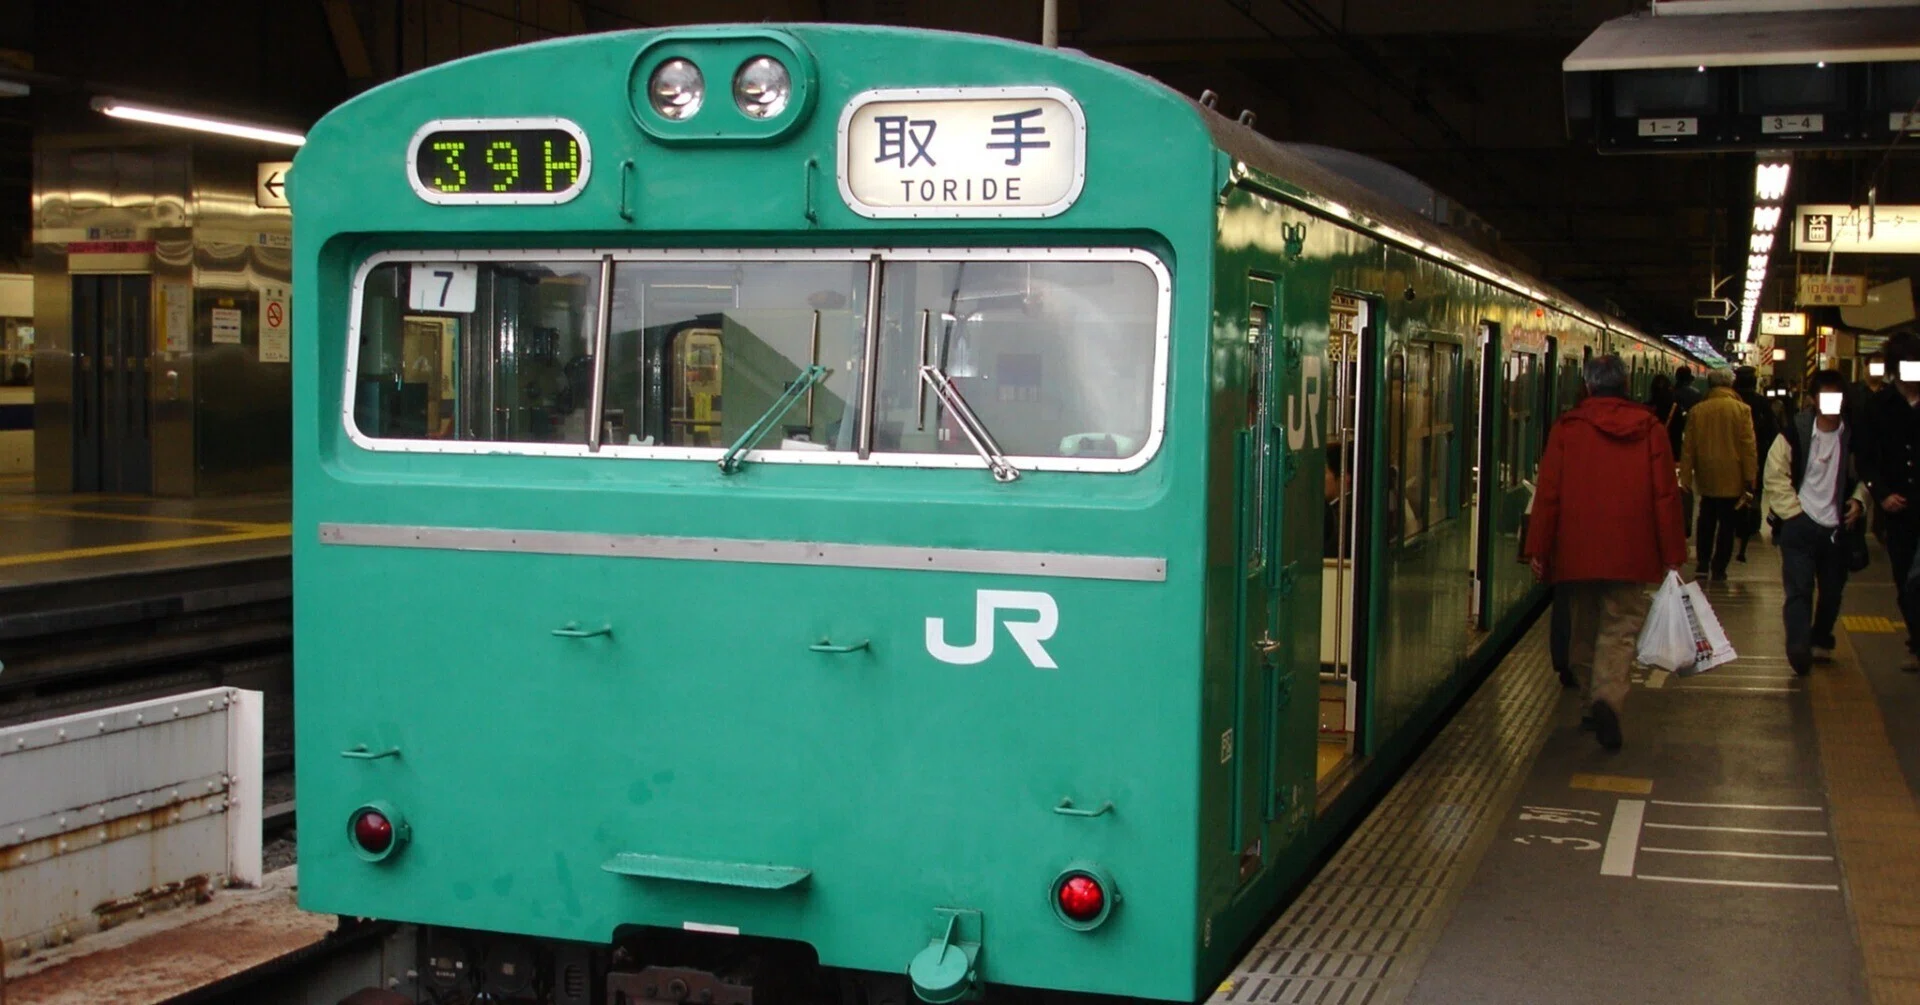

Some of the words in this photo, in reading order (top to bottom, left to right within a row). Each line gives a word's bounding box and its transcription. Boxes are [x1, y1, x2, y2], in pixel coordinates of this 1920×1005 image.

[433, 140, 578, 191] 39H
[874, 107, 1051, 169] 取手
[901, 177, 1021, 202] TORIDE
[433, 270, 454, 308] 7
[1288, 355, 1322, 451] JR
[925, 589, 1059, 669] JR
